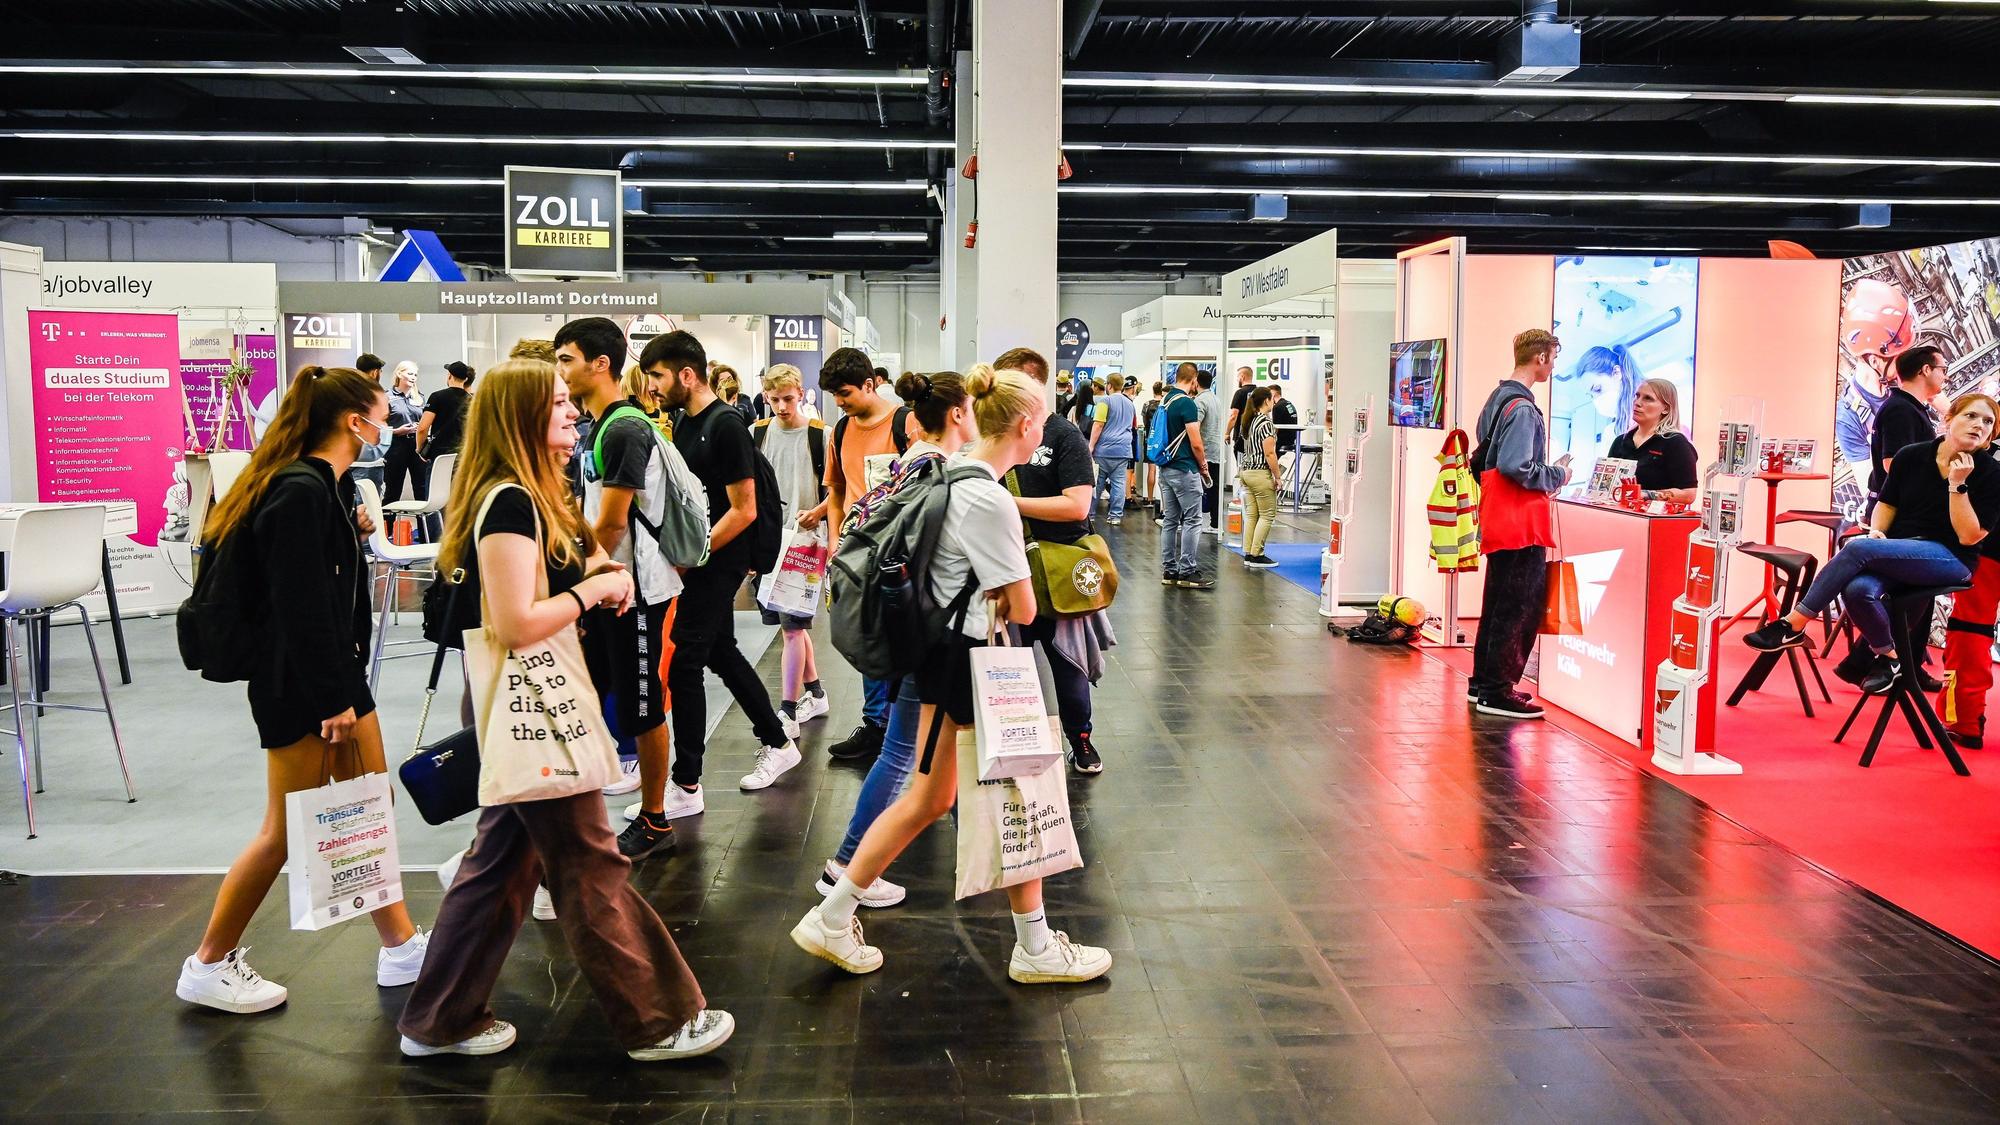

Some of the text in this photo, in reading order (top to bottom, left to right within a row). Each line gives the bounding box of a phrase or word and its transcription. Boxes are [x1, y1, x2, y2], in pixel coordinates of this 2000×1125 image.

[516, 195, 609, 228] ZOLL
[535, 231, 592, 245] KARRIERE
[1241, 264, 1289, 299] DRV Westfalen
[441, 291, 658, 307] Hauptzollamt Dortmund
[292, 315, 352, 337] ZOLL
[639, 324, 660, 333] ZOLL
[774, 318, 818, 339] ZOLL
[189, 336, 220, 348] jobmensa
[1064, 332, 1077, 341] dm
[632, 341, 647, 350] DO
[75, 354, 140, 365] Starte Dein
[1255, 358, 1290, 381] EGU
[50, 372, 165, 384] duales Studium
[64, 392, 154, 402] bei der Telekom
[55, 435, 151, 443] Telekommunikationsinformatik
[55, 447, 119, 455] Informationstechnik
[56, 465, 132, 474] Kommunikationstechnik
[57, 487, 120, 497] Bauingenieurwesen
[108, 554, 132, 562] türlich
[787, 549, 820, 565] AUSBILDUNG
[638, 635, 648, 654] NIKE
[639, 658, 648, 675] NIKE
[1557, 652, 1582, 680] Köln
[546, 674, 566, 689] to
[639, 679, 648, 696] NIKE
[509, 695, 577, 719] disver
[639, 700, 648, 717] NIKE
[511, 723, 547, 741] the
[1000, 726, 1038, 738] VORTEILE
[1003, 801, 1020, 813] Für
[315, 805, 365, 825] Transuse
[317, 824, 388, 853] Zahlenhengst
[1002, 829, 1018, 841] die
[331, 860, 380, 883] VORTEILE
